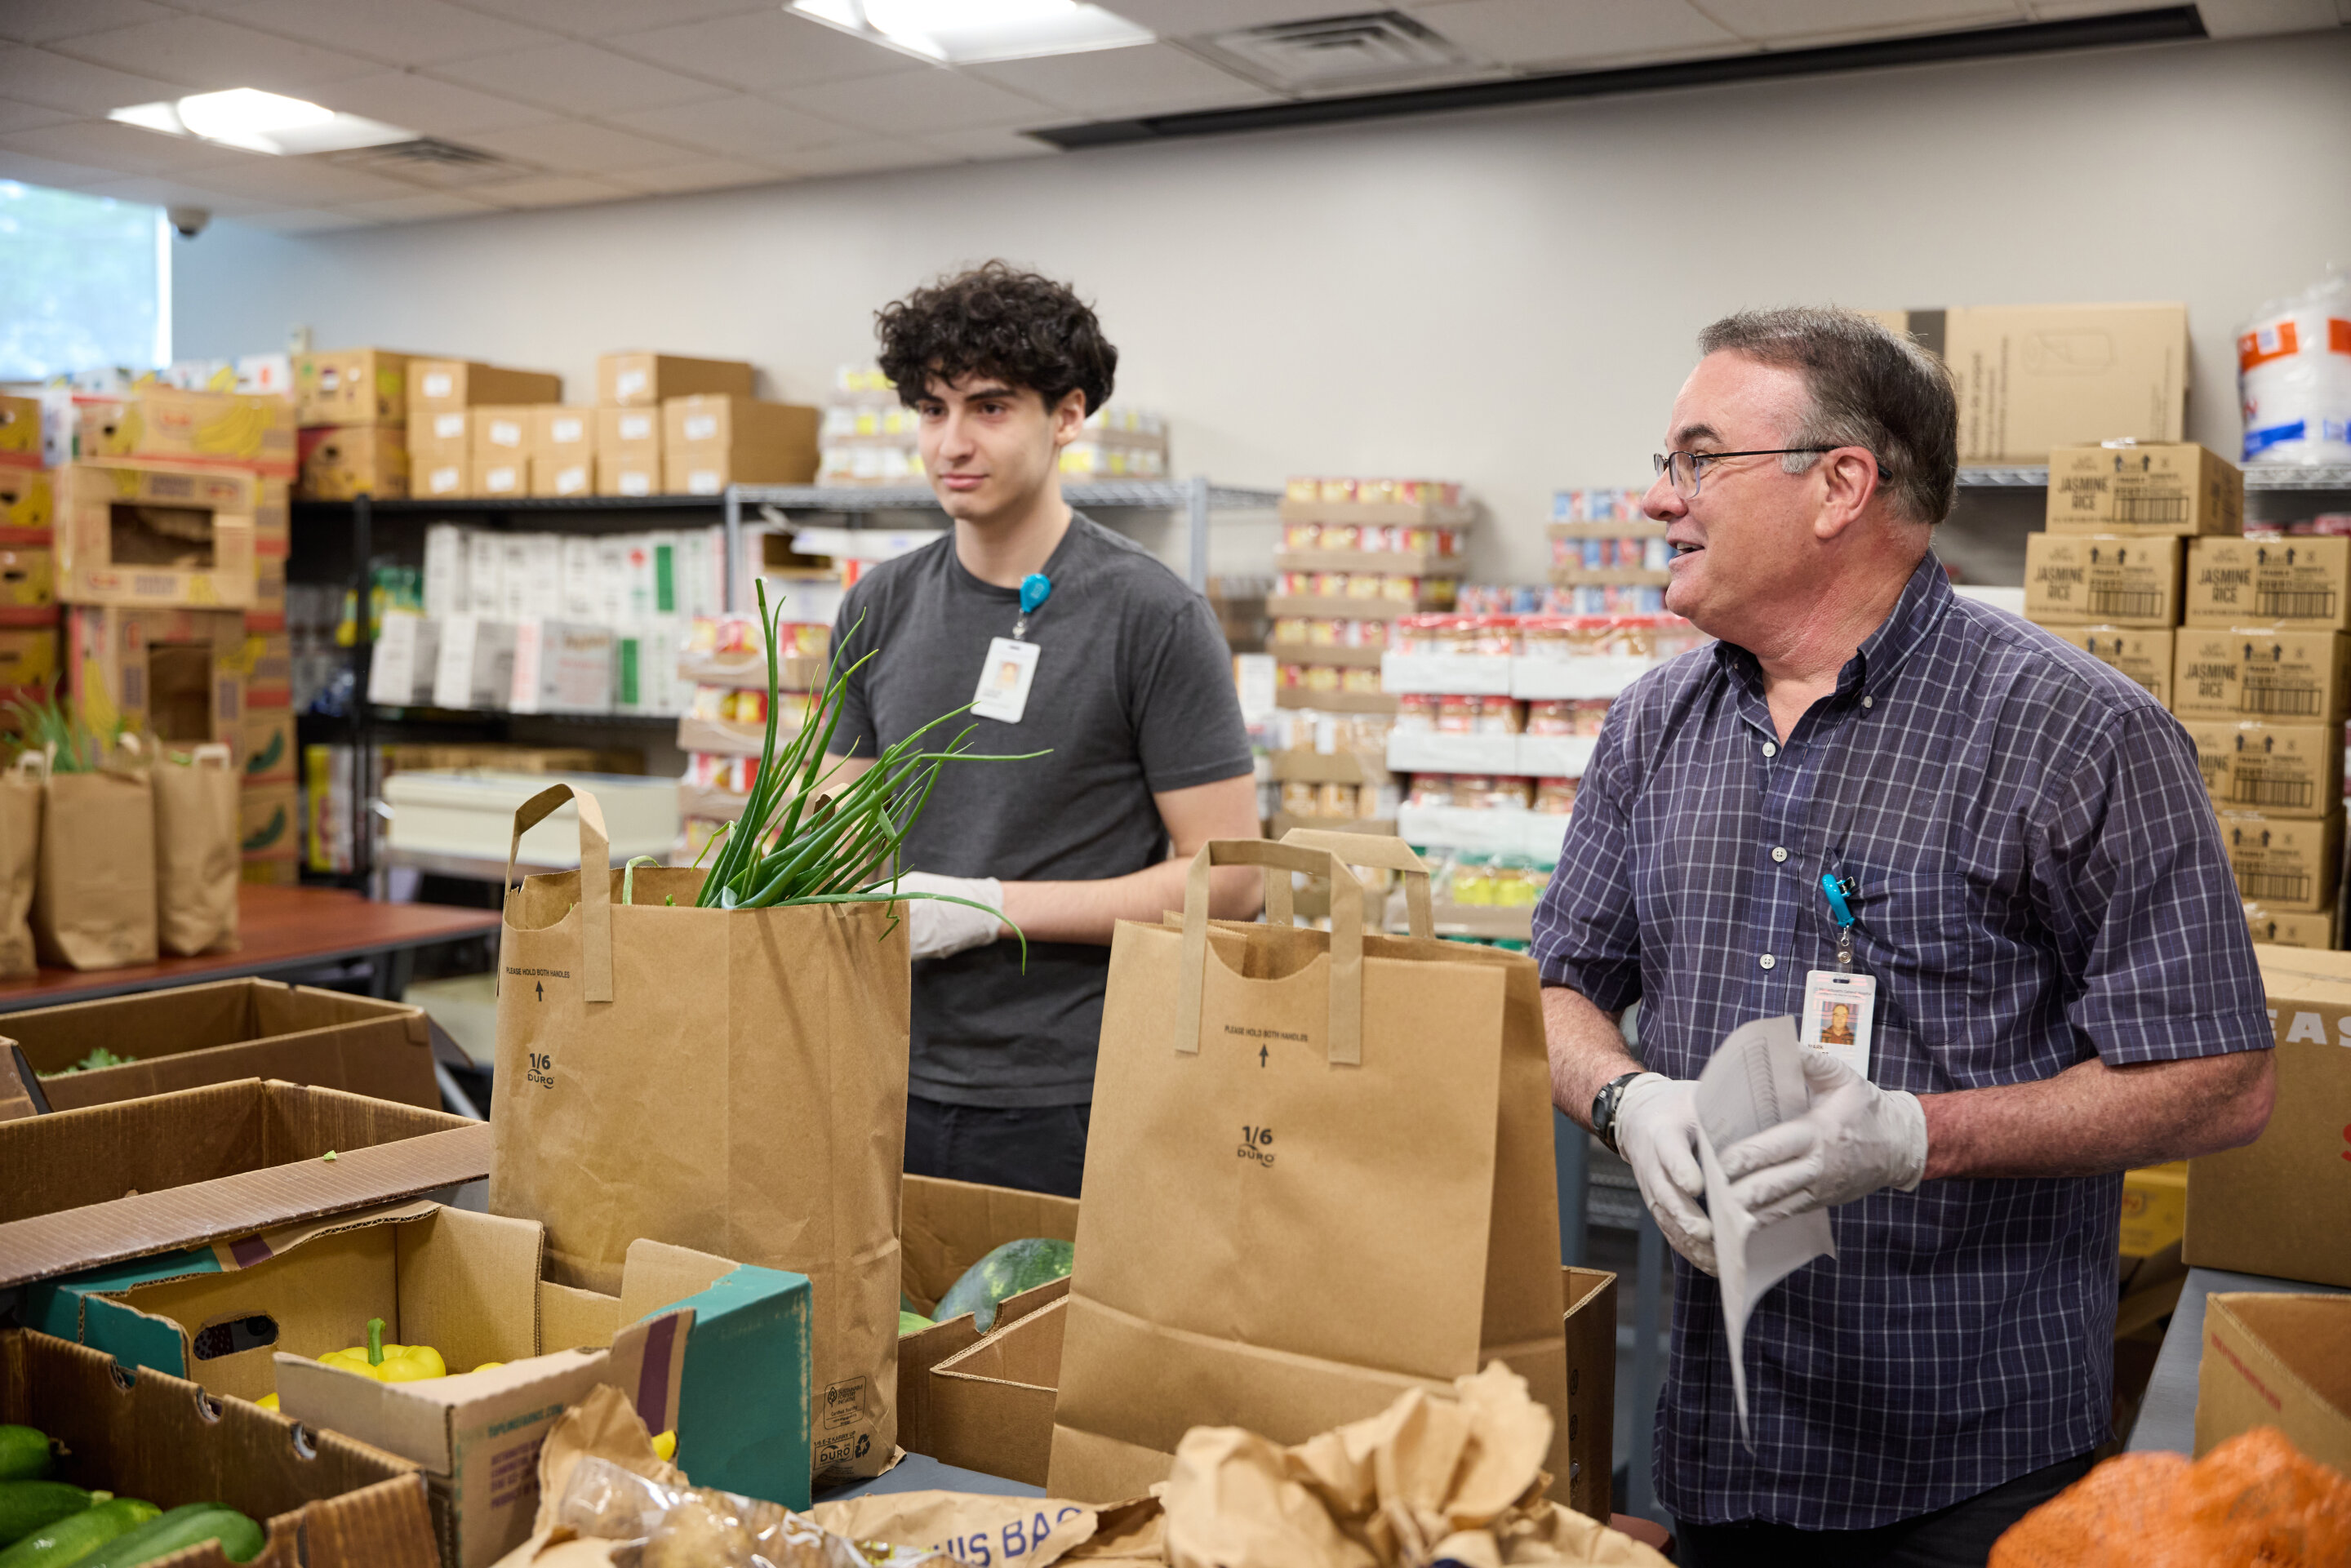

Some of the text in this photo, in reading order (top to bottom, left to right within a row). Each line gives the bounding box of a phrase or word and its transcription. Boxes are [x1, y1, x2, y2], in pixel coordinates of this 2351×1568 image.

[2058, 476, 2109, 494] JASMINE
[2071, 495, 2096, 510] RICE
[2034, 566, 2084, 584] JASMINE
[2198, 568, 2251, 586] JASMINE
[2047, 584, 2071, 601] RICE
[2211, 587, 2238, 604] RICE
[2184, 663, 2238, 682] JASMINE
[2198, 682, 2224, 699] RICE
[506, 966, 570, 979] PLEASE HOLD BOTH HANDLES
[1224, 1024, 1309, 1042] PLEASE HOLD BOTH HANDLES
[530, 1053, 551, 1070] 1/6
[527, 1072, 554, 1086] DURO
[1242, 1126, 1273, 1145] 1/6
[1238, 1148, 1274, 1164] DURO
[833, 1433, 849, 1442] KARRY
[820, 1447, 851, 1462] DURO
